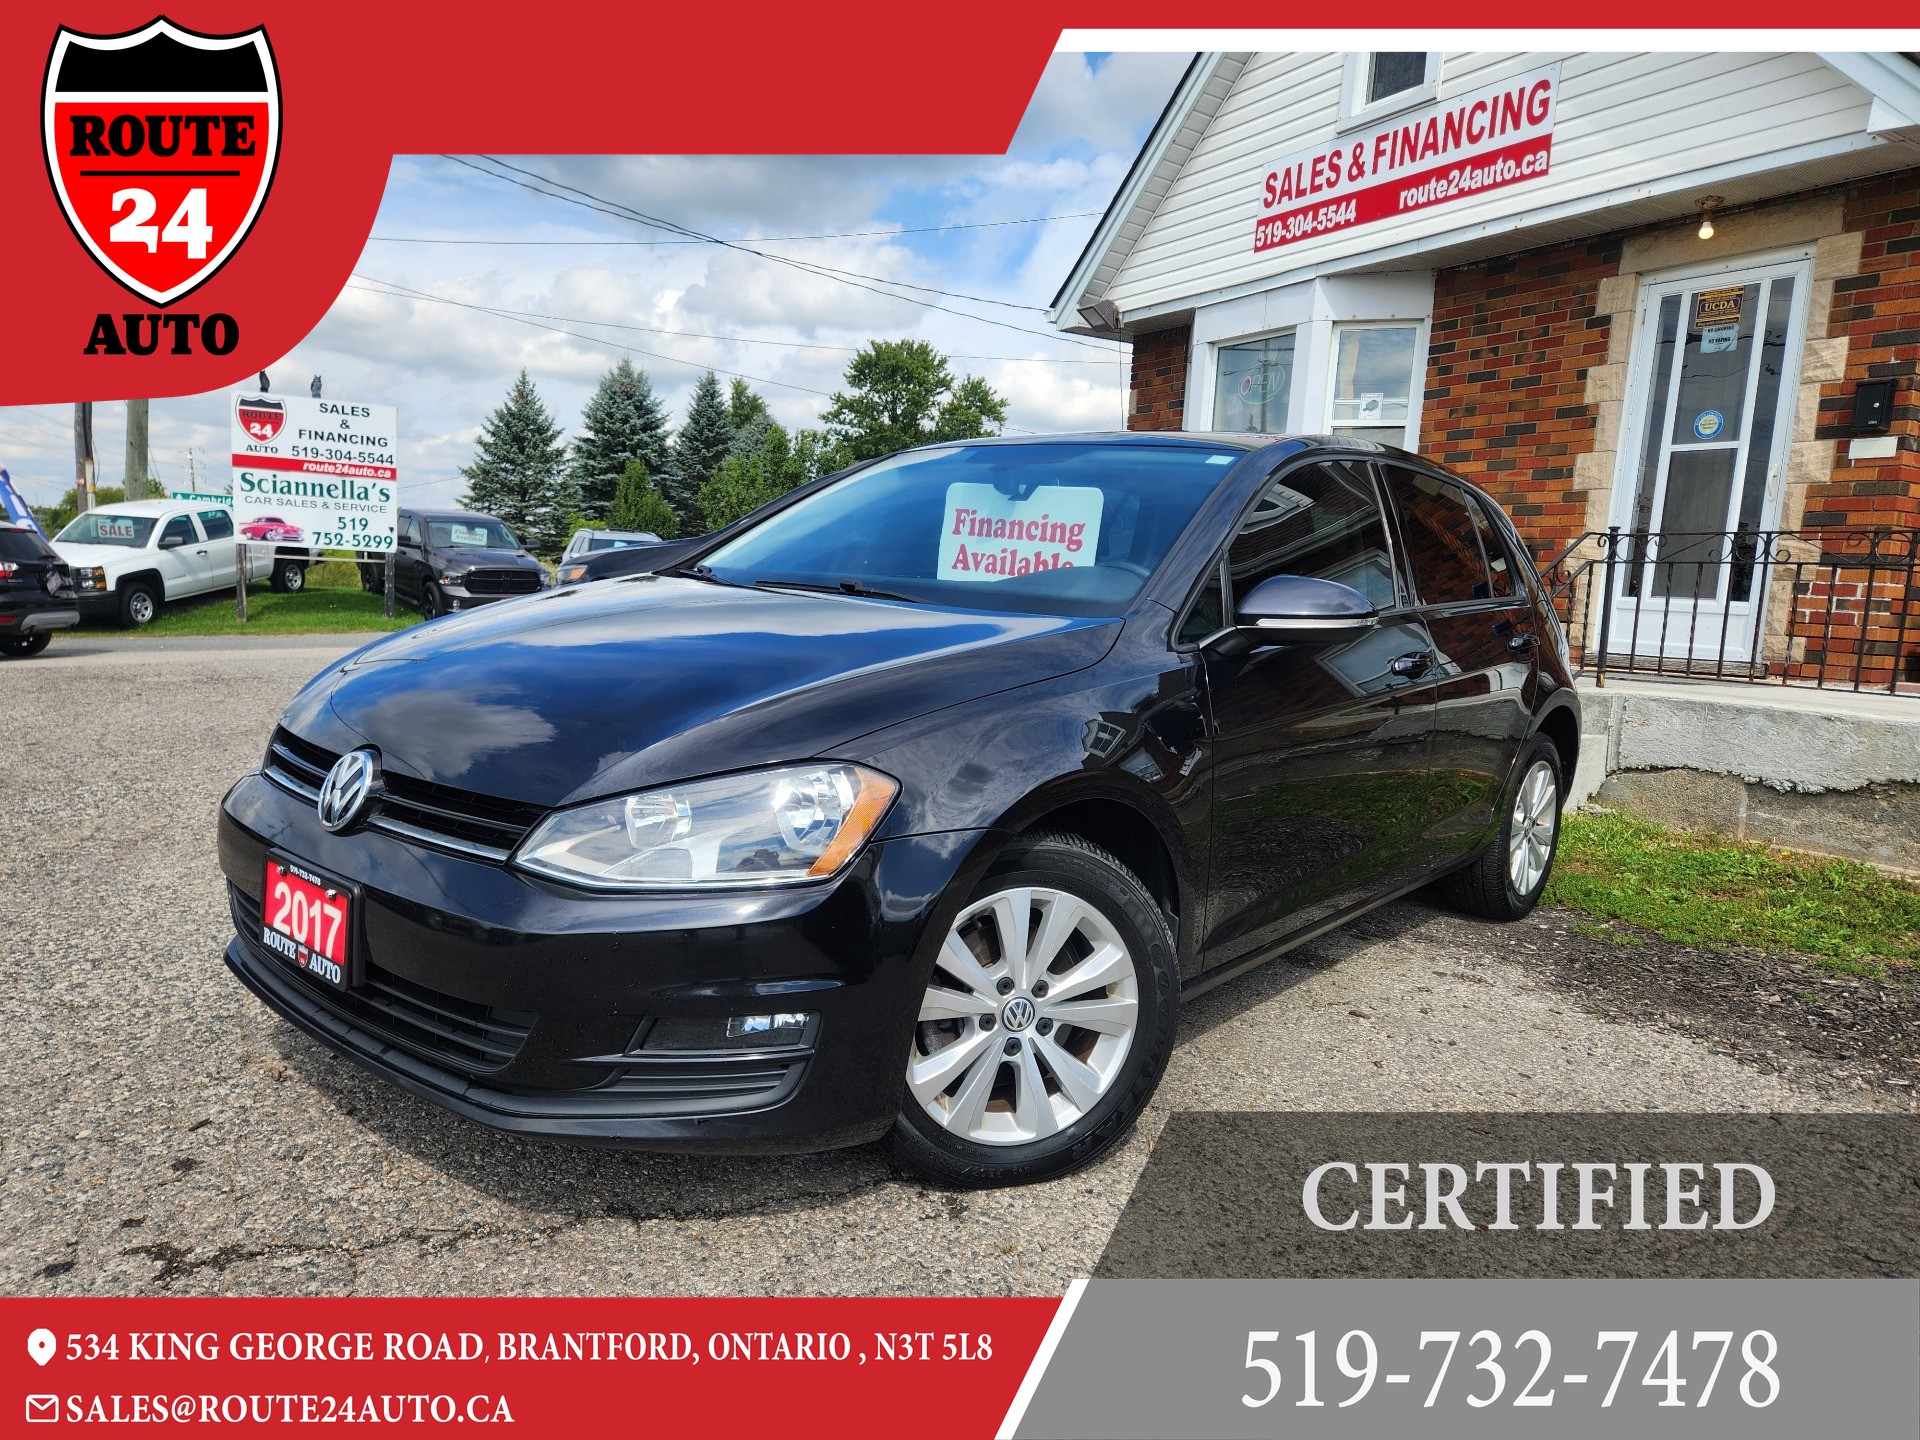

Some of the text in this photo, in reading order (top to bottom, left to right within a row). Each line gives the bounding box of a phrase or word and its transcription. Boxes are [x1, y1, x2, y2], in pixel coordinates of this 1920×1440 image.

[1262, 79, 1552, 209] SALES & FINANCING
[1399, 150, 1549, 210] route24auto.ca
[1255, 199, 1357, 248] 519-304-5544
[1705, 300, 1736, 312] UCDA
[1240, 371, 1281, 395] OPEN
[242, 410, 282, 421] ROUTE
[319, 402, 370, 418] SALES
[249, 422, 273, 438] 24
[339, 419, 350, 429] &
[298, 428, 388, 448] FINANCING
[245, 444, 278, 454] AUTO
[291, 445, 394, 465] 519-304-5544
[302, 461, 392, 479] route24auto.ca
[240, 472, 391, 503] Sciannella's
[244, 495, 387, 514] CAR SALES & SERVICE
[100, 525, 133, 537] SALE
[338, 516, 369, 531] 519
[952, 508, 1086, 553] Financing
[312, 531, 394, 550] 752-5299
[289, 864, 322, 886] 519-732-7478
[273, 881, 342, 960] 2017
[263, 926, 341, 984] ROUTE AUTO
